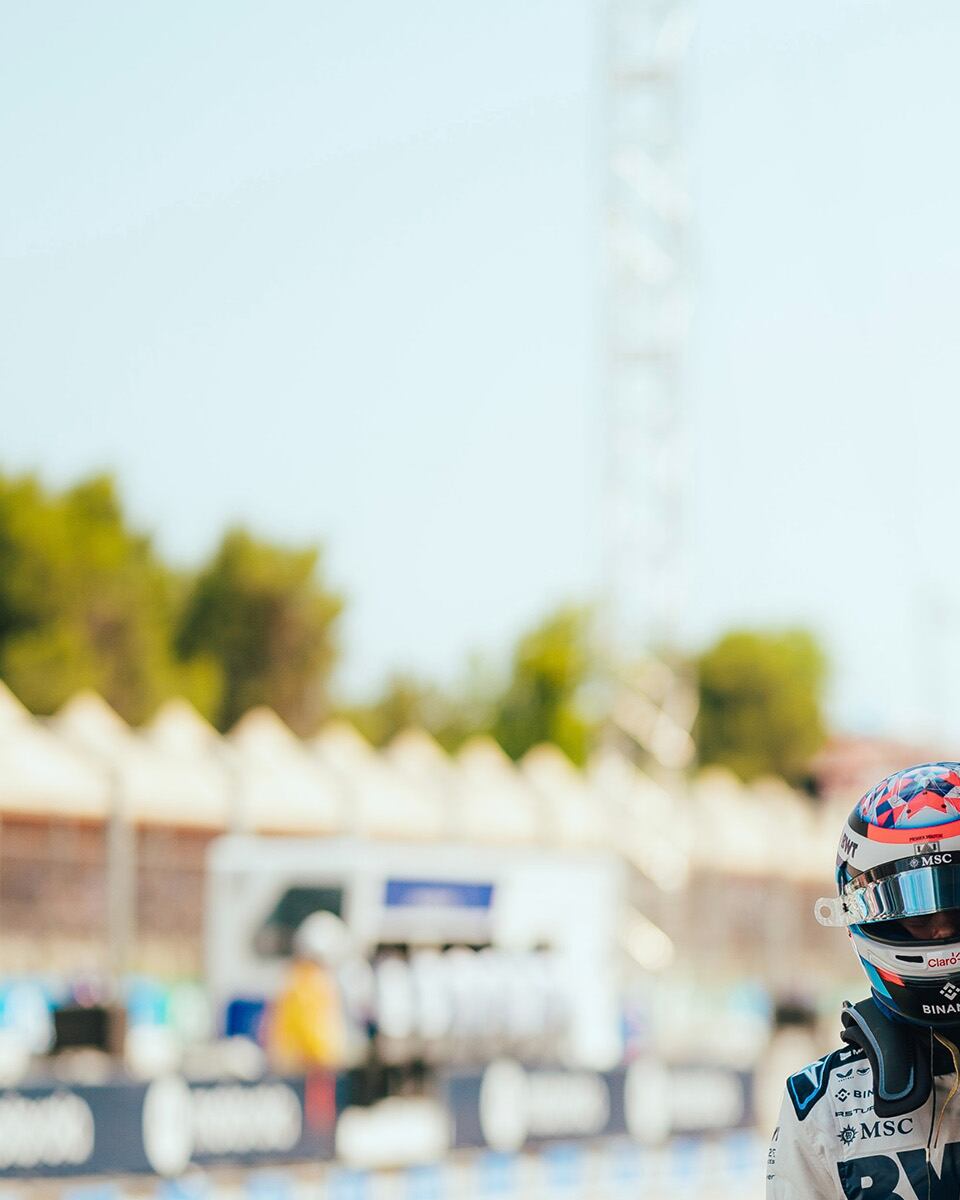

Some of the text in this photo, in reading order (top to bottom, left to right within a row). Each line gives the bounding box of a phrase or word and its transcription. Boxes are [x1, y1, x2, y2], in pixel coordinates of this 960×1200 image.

[921, 854, 952, 866] MSC
[928, 956, 958, 968] Claro
[860, 1118, 913, 1139] MSC
